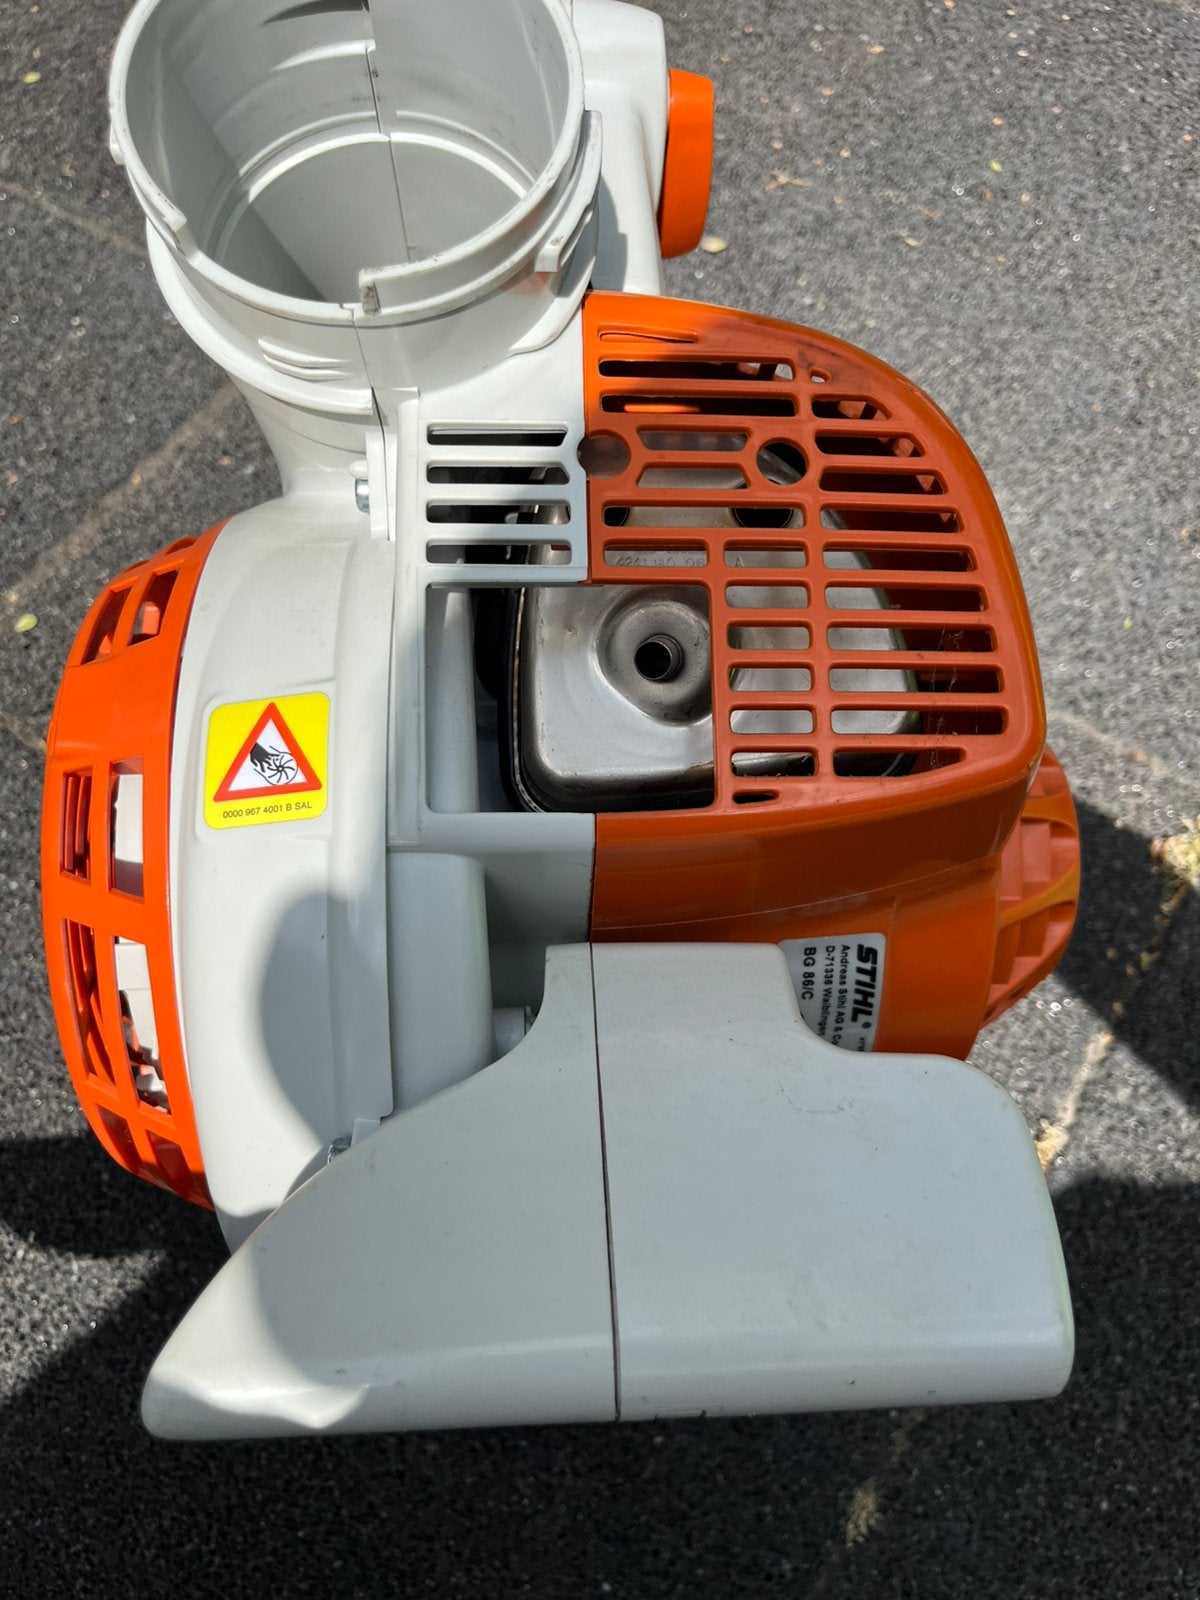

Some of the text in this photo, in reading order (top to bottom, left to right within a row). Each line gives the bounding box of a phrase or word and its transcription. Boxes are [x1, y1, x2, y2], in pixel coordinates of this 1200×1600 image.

[223, 801, 312, 818] 0000 967 4001 B SAL
[801, 947, 816, 1000] BG 86/C
[824, 945, 835, 985] D-71336
[838, 945, 850, 985] Andreas
[851, 943, 878, 1022] STIHL
[835, 1011, 845, 1024] AG
[836, 988, 847, 1009] Stihl
